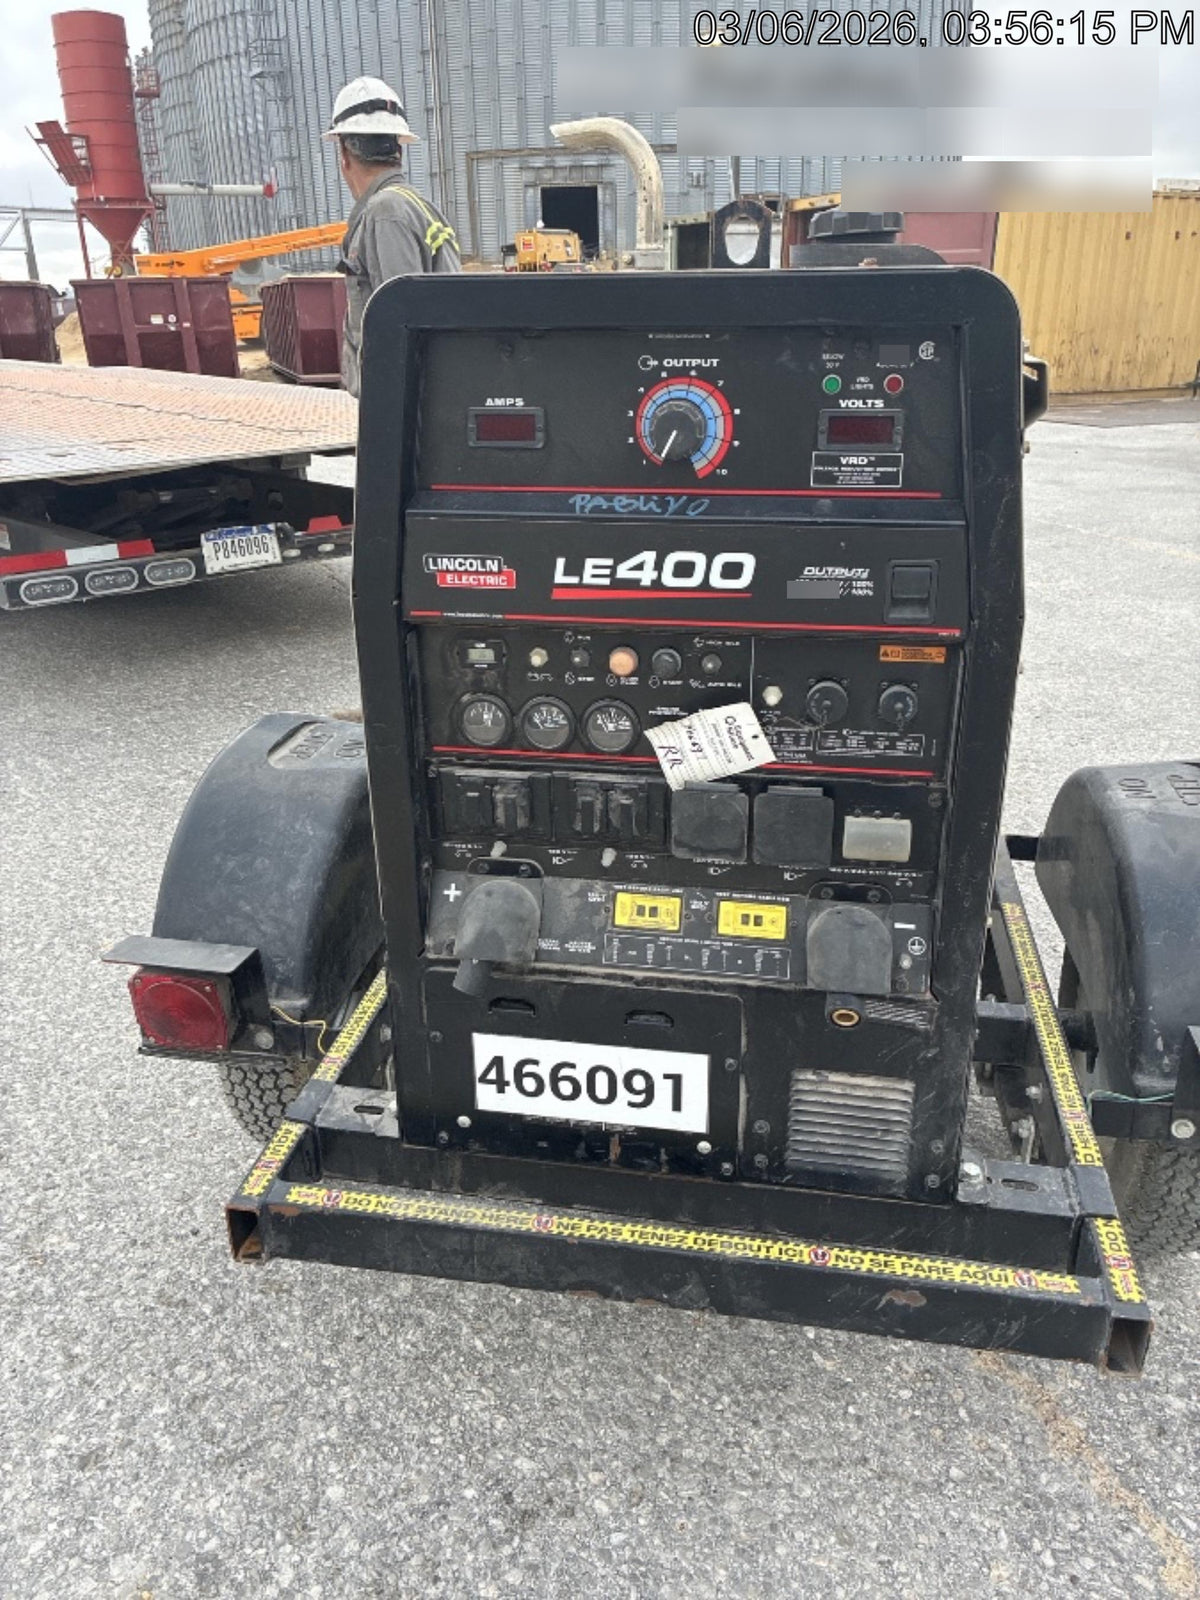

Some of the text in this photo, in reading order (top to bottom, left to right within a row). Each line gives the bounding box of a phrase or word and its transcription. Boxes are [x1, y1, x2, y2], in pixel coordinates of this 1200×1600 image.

[662, 358, 720, 367] OUTPUT
[485, 397, 525, 407] AMPS
[839, 399, 885, 408] VOLTS
[428, 556, 499, 573] LINCOLN
[554, 550, 756, 590] LE400
[446, 573, 508, 586] ELECTRIC
[477, 1055, 684, 1113] 466091
[345, 1195, 371, 1207] DO
[557, 1221, 804, 1258] NE PAS TENEZ DEBOUT ICI
[834, 1253, 1010, 1285] NO SE PARE AQUI
